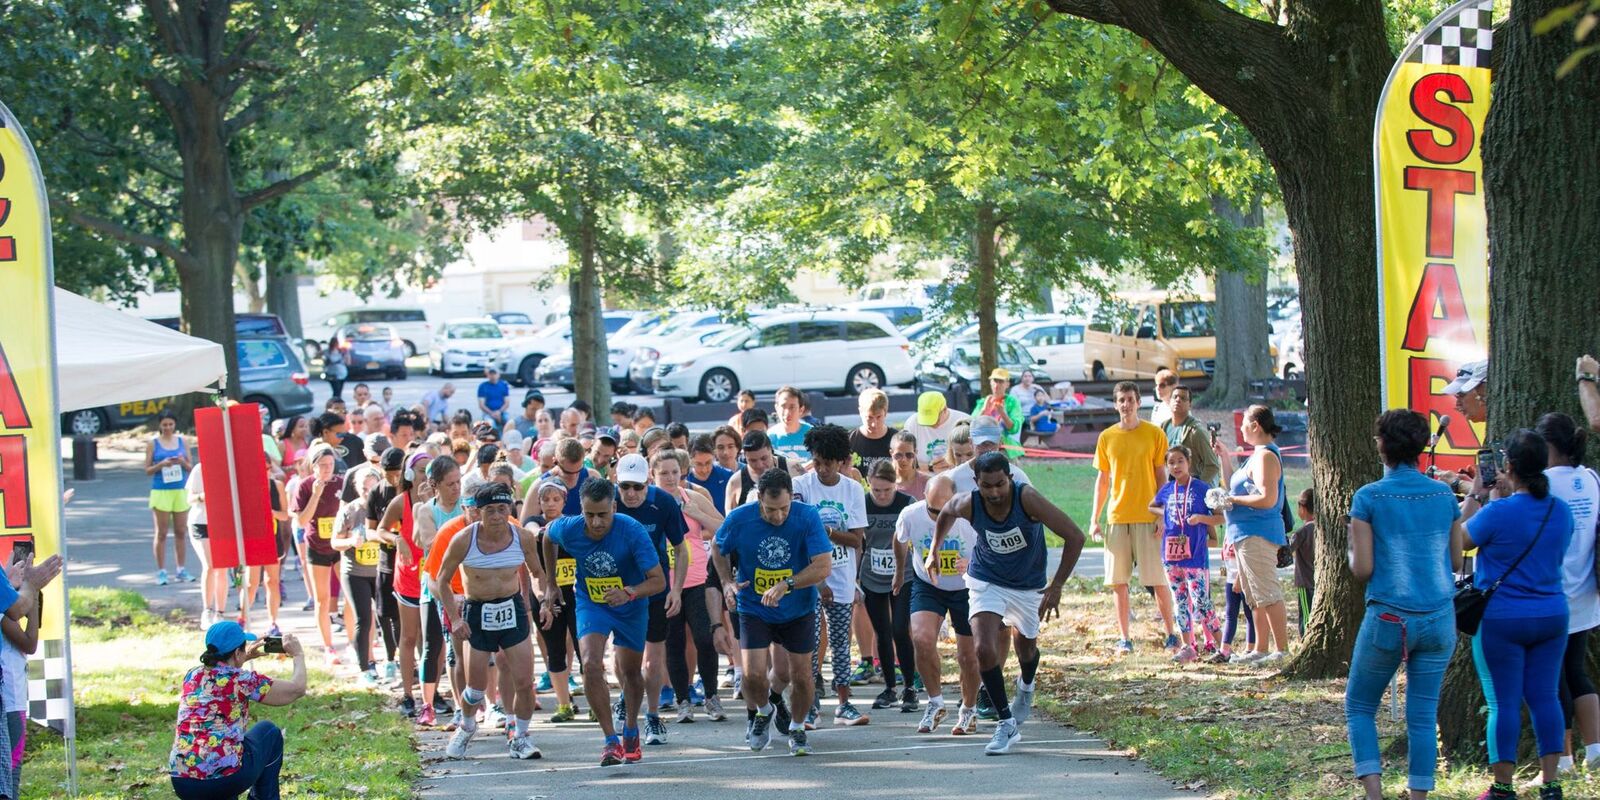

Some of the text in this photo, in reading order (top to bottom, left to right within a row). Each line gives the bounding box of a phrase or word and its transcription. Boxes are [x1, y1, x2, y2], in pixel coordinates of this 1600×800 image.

[1400, 72, 1484, 474] STAR
[357, 548, 380, 560] T93
[872, 556, 896, 569] H42
